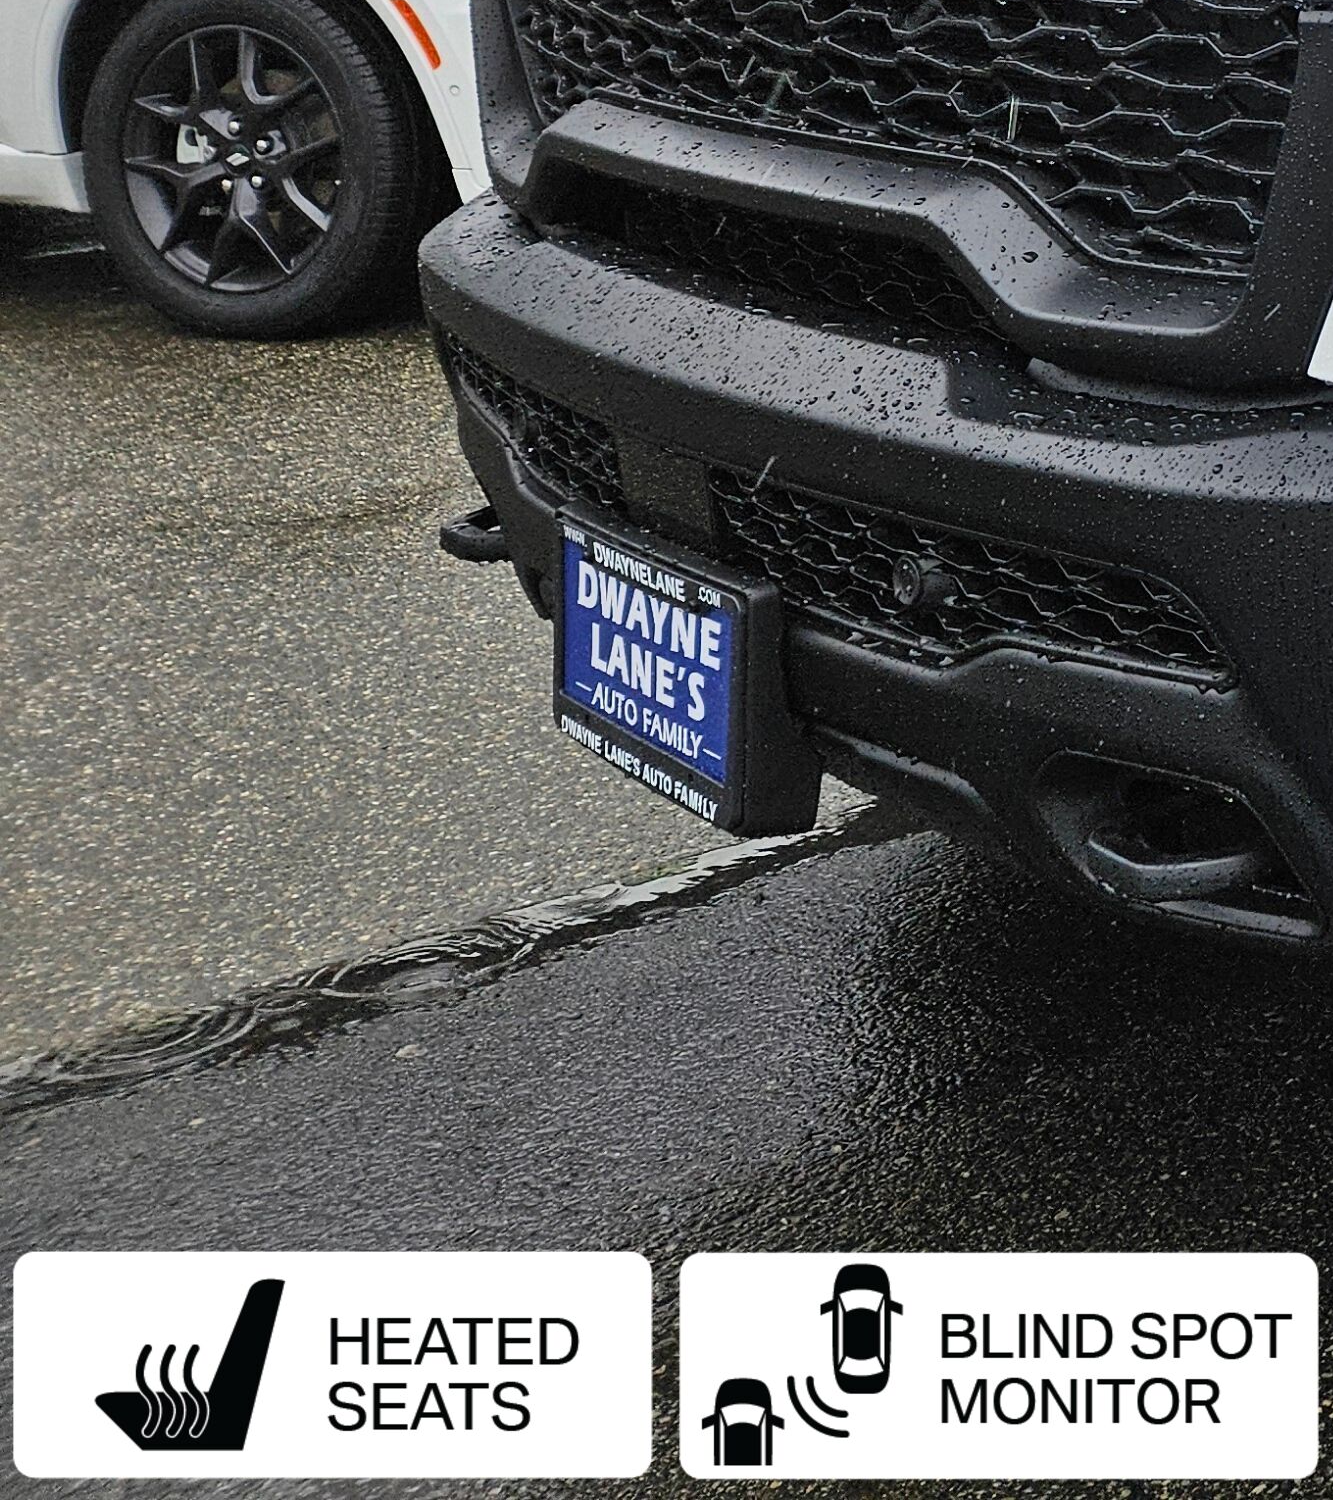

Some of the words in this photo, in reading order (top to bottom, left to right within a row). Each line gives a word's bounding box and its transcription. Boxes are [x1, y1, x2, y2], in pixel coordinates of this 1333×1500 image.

[576, 559, 722, 672] DWAYNE
[592, 541, 687, 603] DWAYNELANE
[589, 621, 706, 723] LANE'S
[590, 681, 638, 727] AUTO
[642, 707, 704, 760] FAMILY
[560, 714, 602, 754] DWAYNE
[604, 740, 641, 777] LANE'S
[641, 763, 673, 795] AUTO
[673, 780, 719, 822] FAMILY
